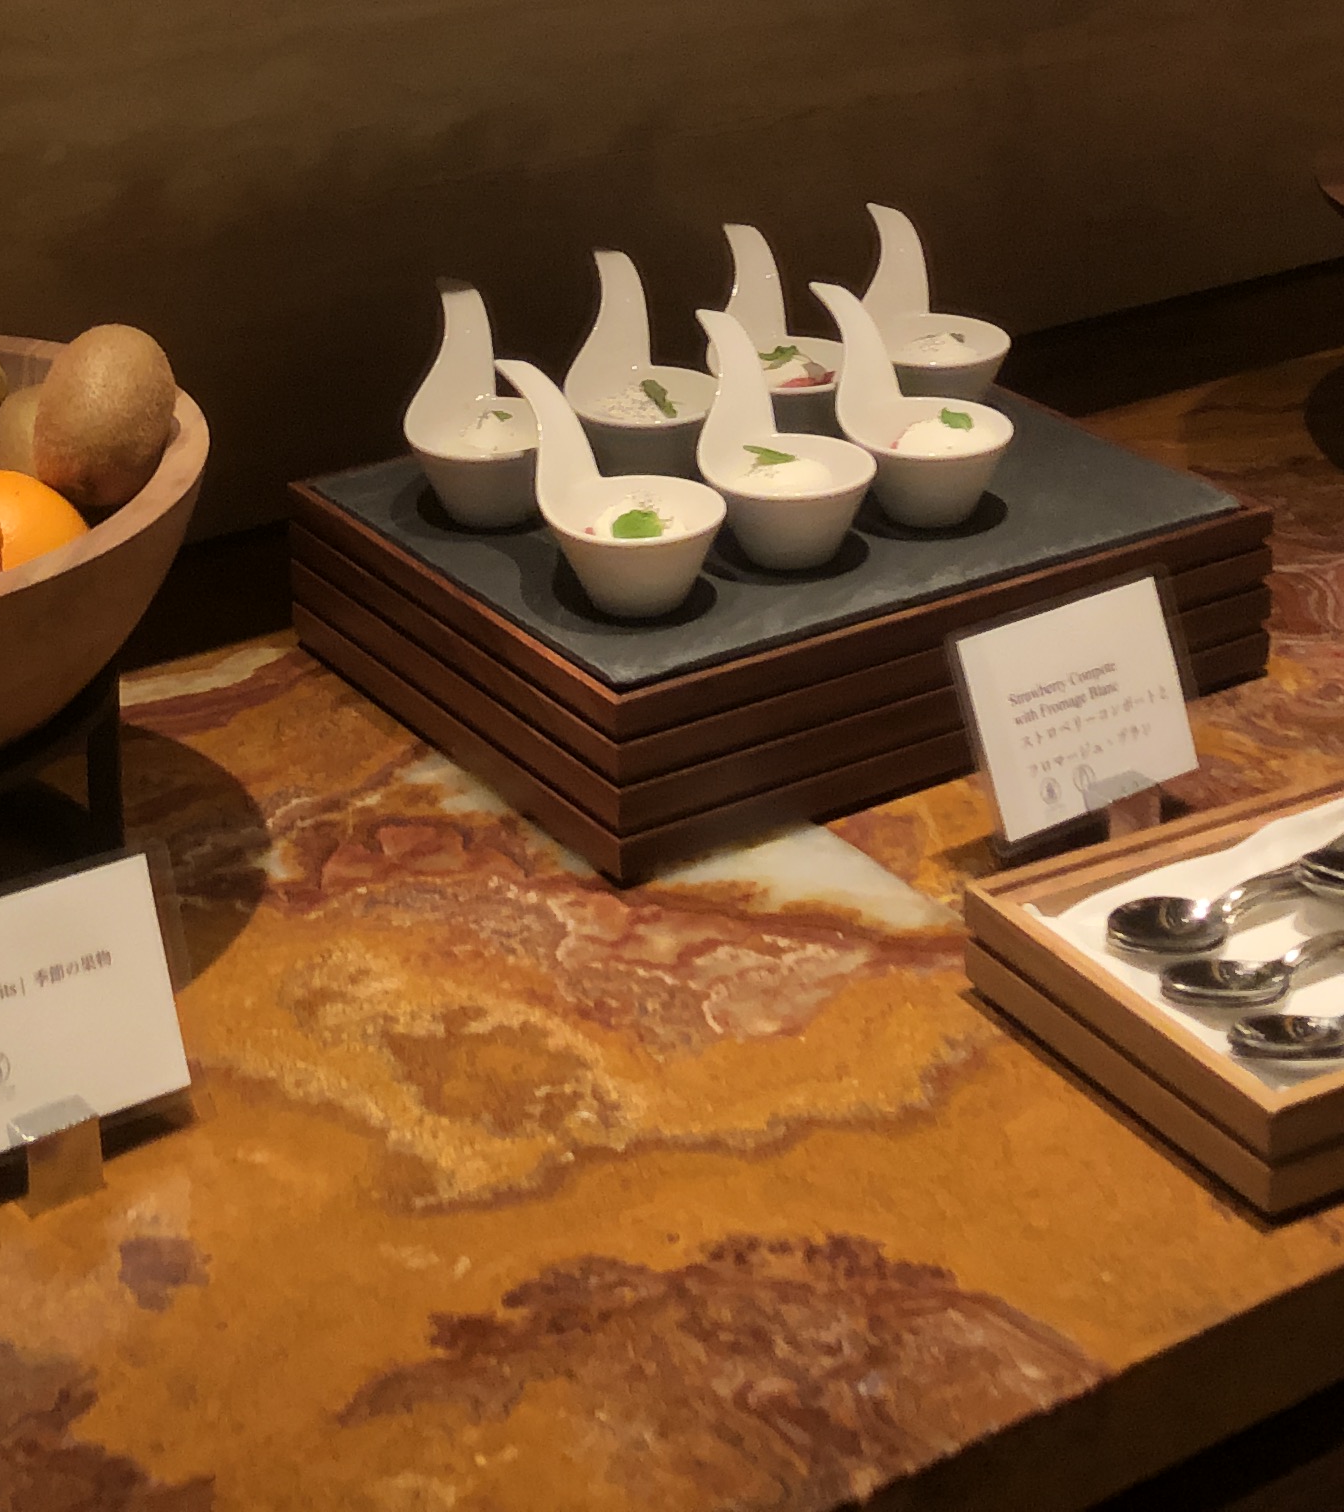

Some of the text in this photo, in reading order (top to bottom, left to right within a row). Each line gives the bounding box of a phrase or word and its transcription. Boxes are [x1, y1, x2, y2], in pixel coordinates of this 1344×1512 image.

[1008, 662, 1116, 707] Strawberry Compote
[1014, 682, 1119, 726] with Fromage Blanc
[33, 949, 113, 988] 季節の果物
